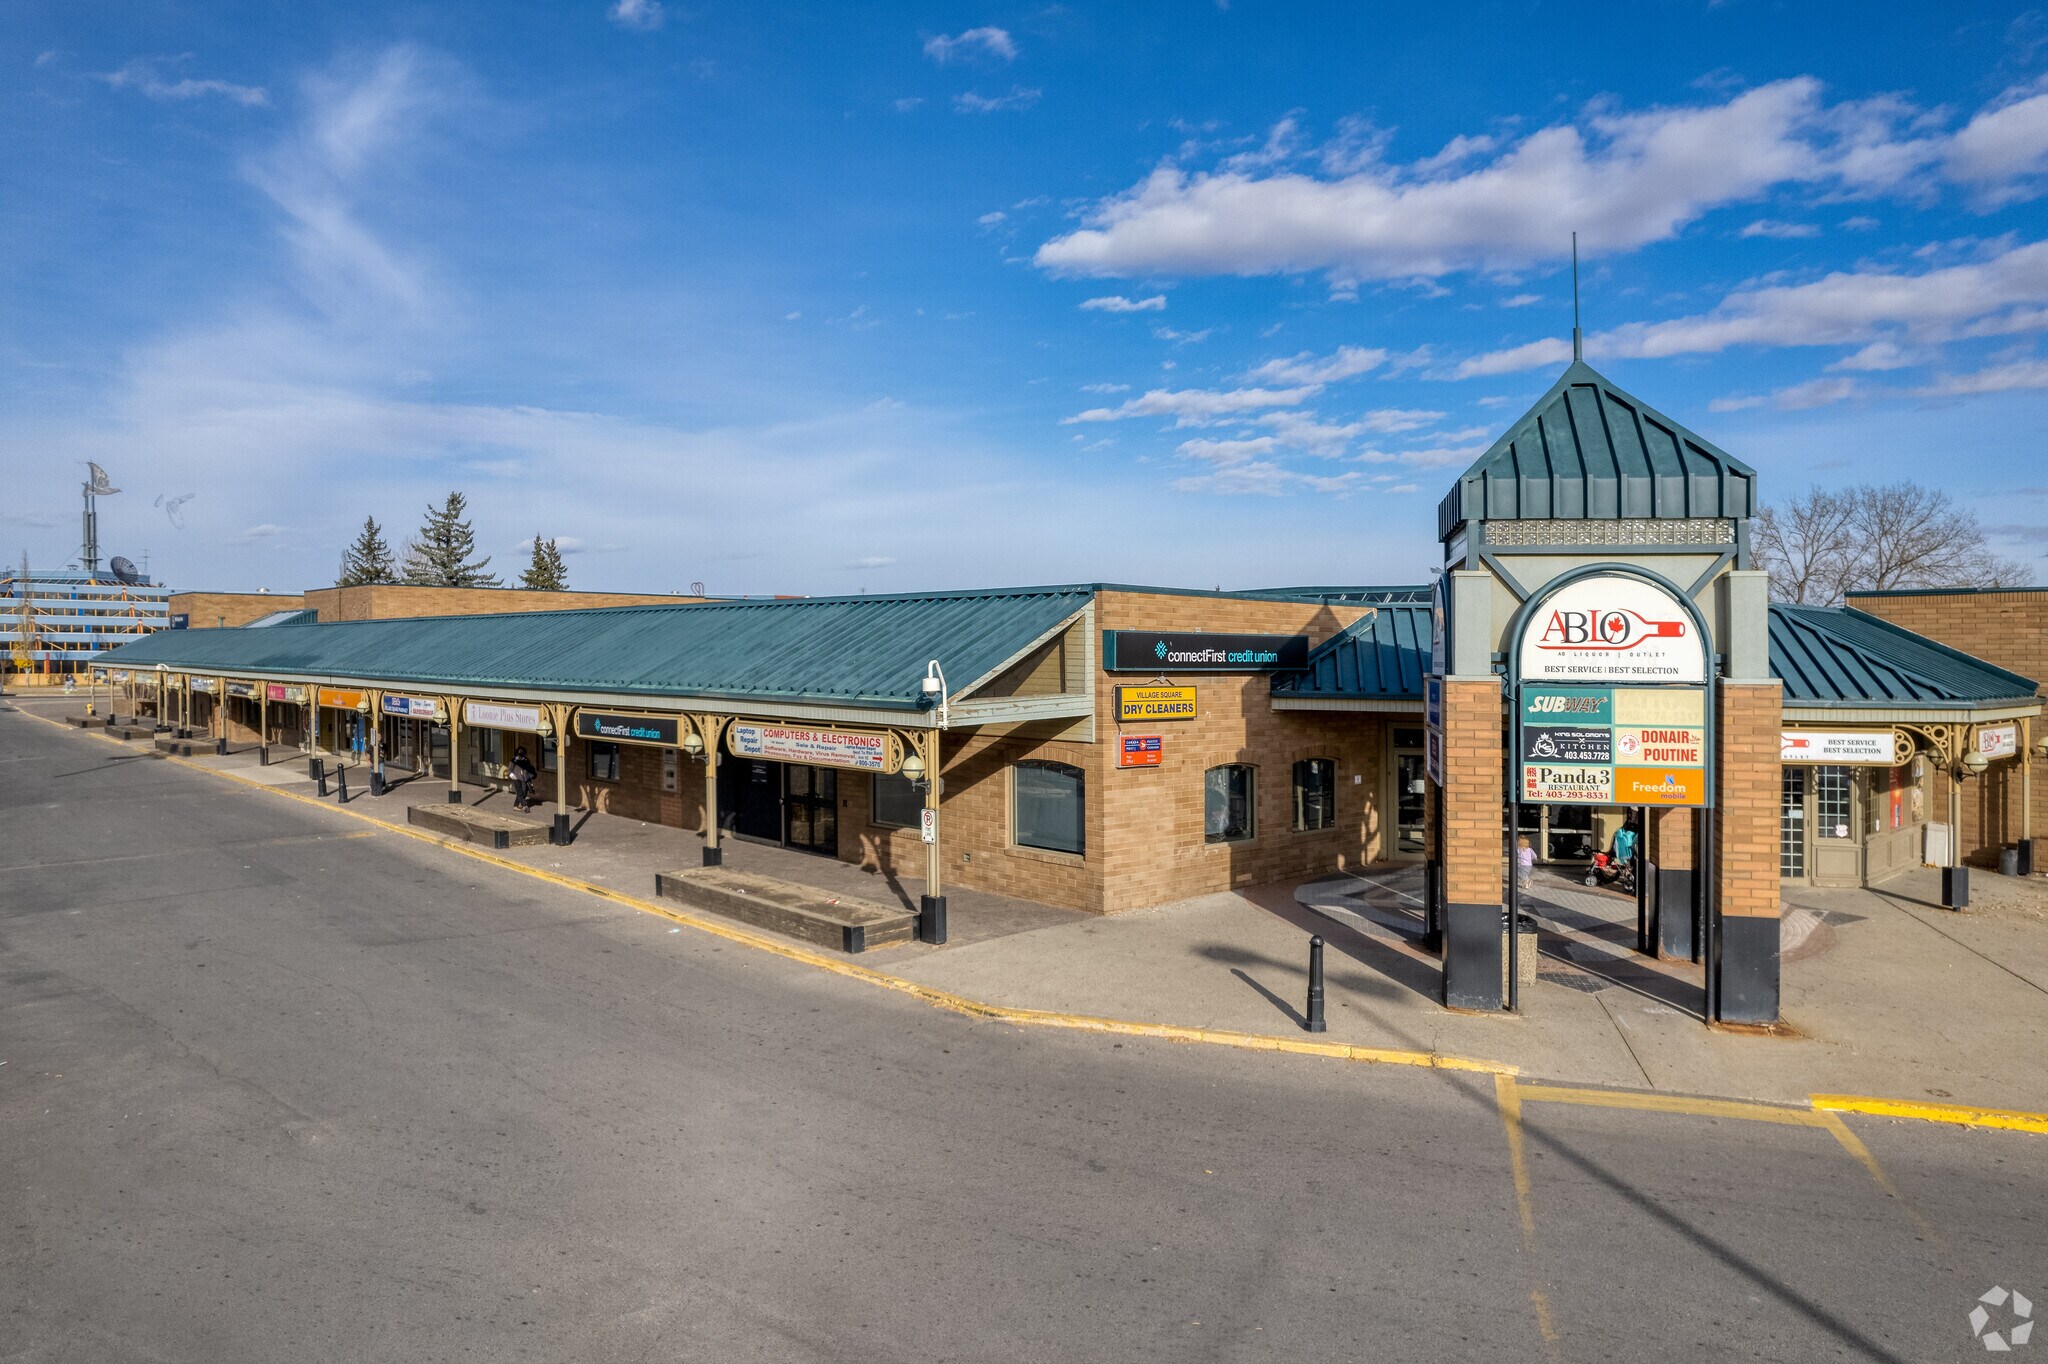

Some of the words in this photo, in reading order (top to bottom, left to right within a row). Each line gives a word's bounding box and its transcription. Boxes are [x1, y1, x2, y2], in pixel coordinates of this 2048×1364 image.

[1540, 609, 1631, 644] ABLO
[1168, 648, 1226, 662] connectFirst
[1228, 649, 1254, 662] credit
[1254, 650, 1278, 663] union
[1544, 665, 1566, 673] BEST
[1567, 666, 1603, 674] SERVICE
[1608, 666, 1631, 674] BEST
[1631, 666, 1679, 675] SELECTION
[1136, 691, 1160, 699] VILLAGE
[1123, 704, 1144, 715] DRY
[1145, 703, 1194, 714] CLEANERS
[1528, 696, 1608, 713] SUBWAY
[478, 706, 499, 719] Loonie
[500, 708, 514, 721] Plus
[515, 710, 536, 725] Stores
[600, 725, 630, 736] connectFirst
[630, 727, 646, 737] credit
[645, 728, 661, 739] union
[736, 727, 756, 735] Laptop
[1641, 730, 1689, 743] DONAIR
[740, 736, 758, 744] Repair
[763, 728, 810, 741] COMPUTERS
[812, 732, 818, 741] &
[822, 734, 881, 748] ELECTRONICS
[744, 745, 761, 753] Depot
[788, 748, 814, 756] Hardware,
[830, 752, 857, 760] Removal,
[1644, 749, 1698, 761] POUTINE
[1564, 751, 1610, 760] 403.453.7728
[1539, 768, 1597, 784] Panda
[1600, 769, 1610, 785] 3
[1632, 781, 1686, 793] Freedom
[1527, 790, 1543, 798] Tel:
[1546, 790, 1609, 799] 403-293-8331
